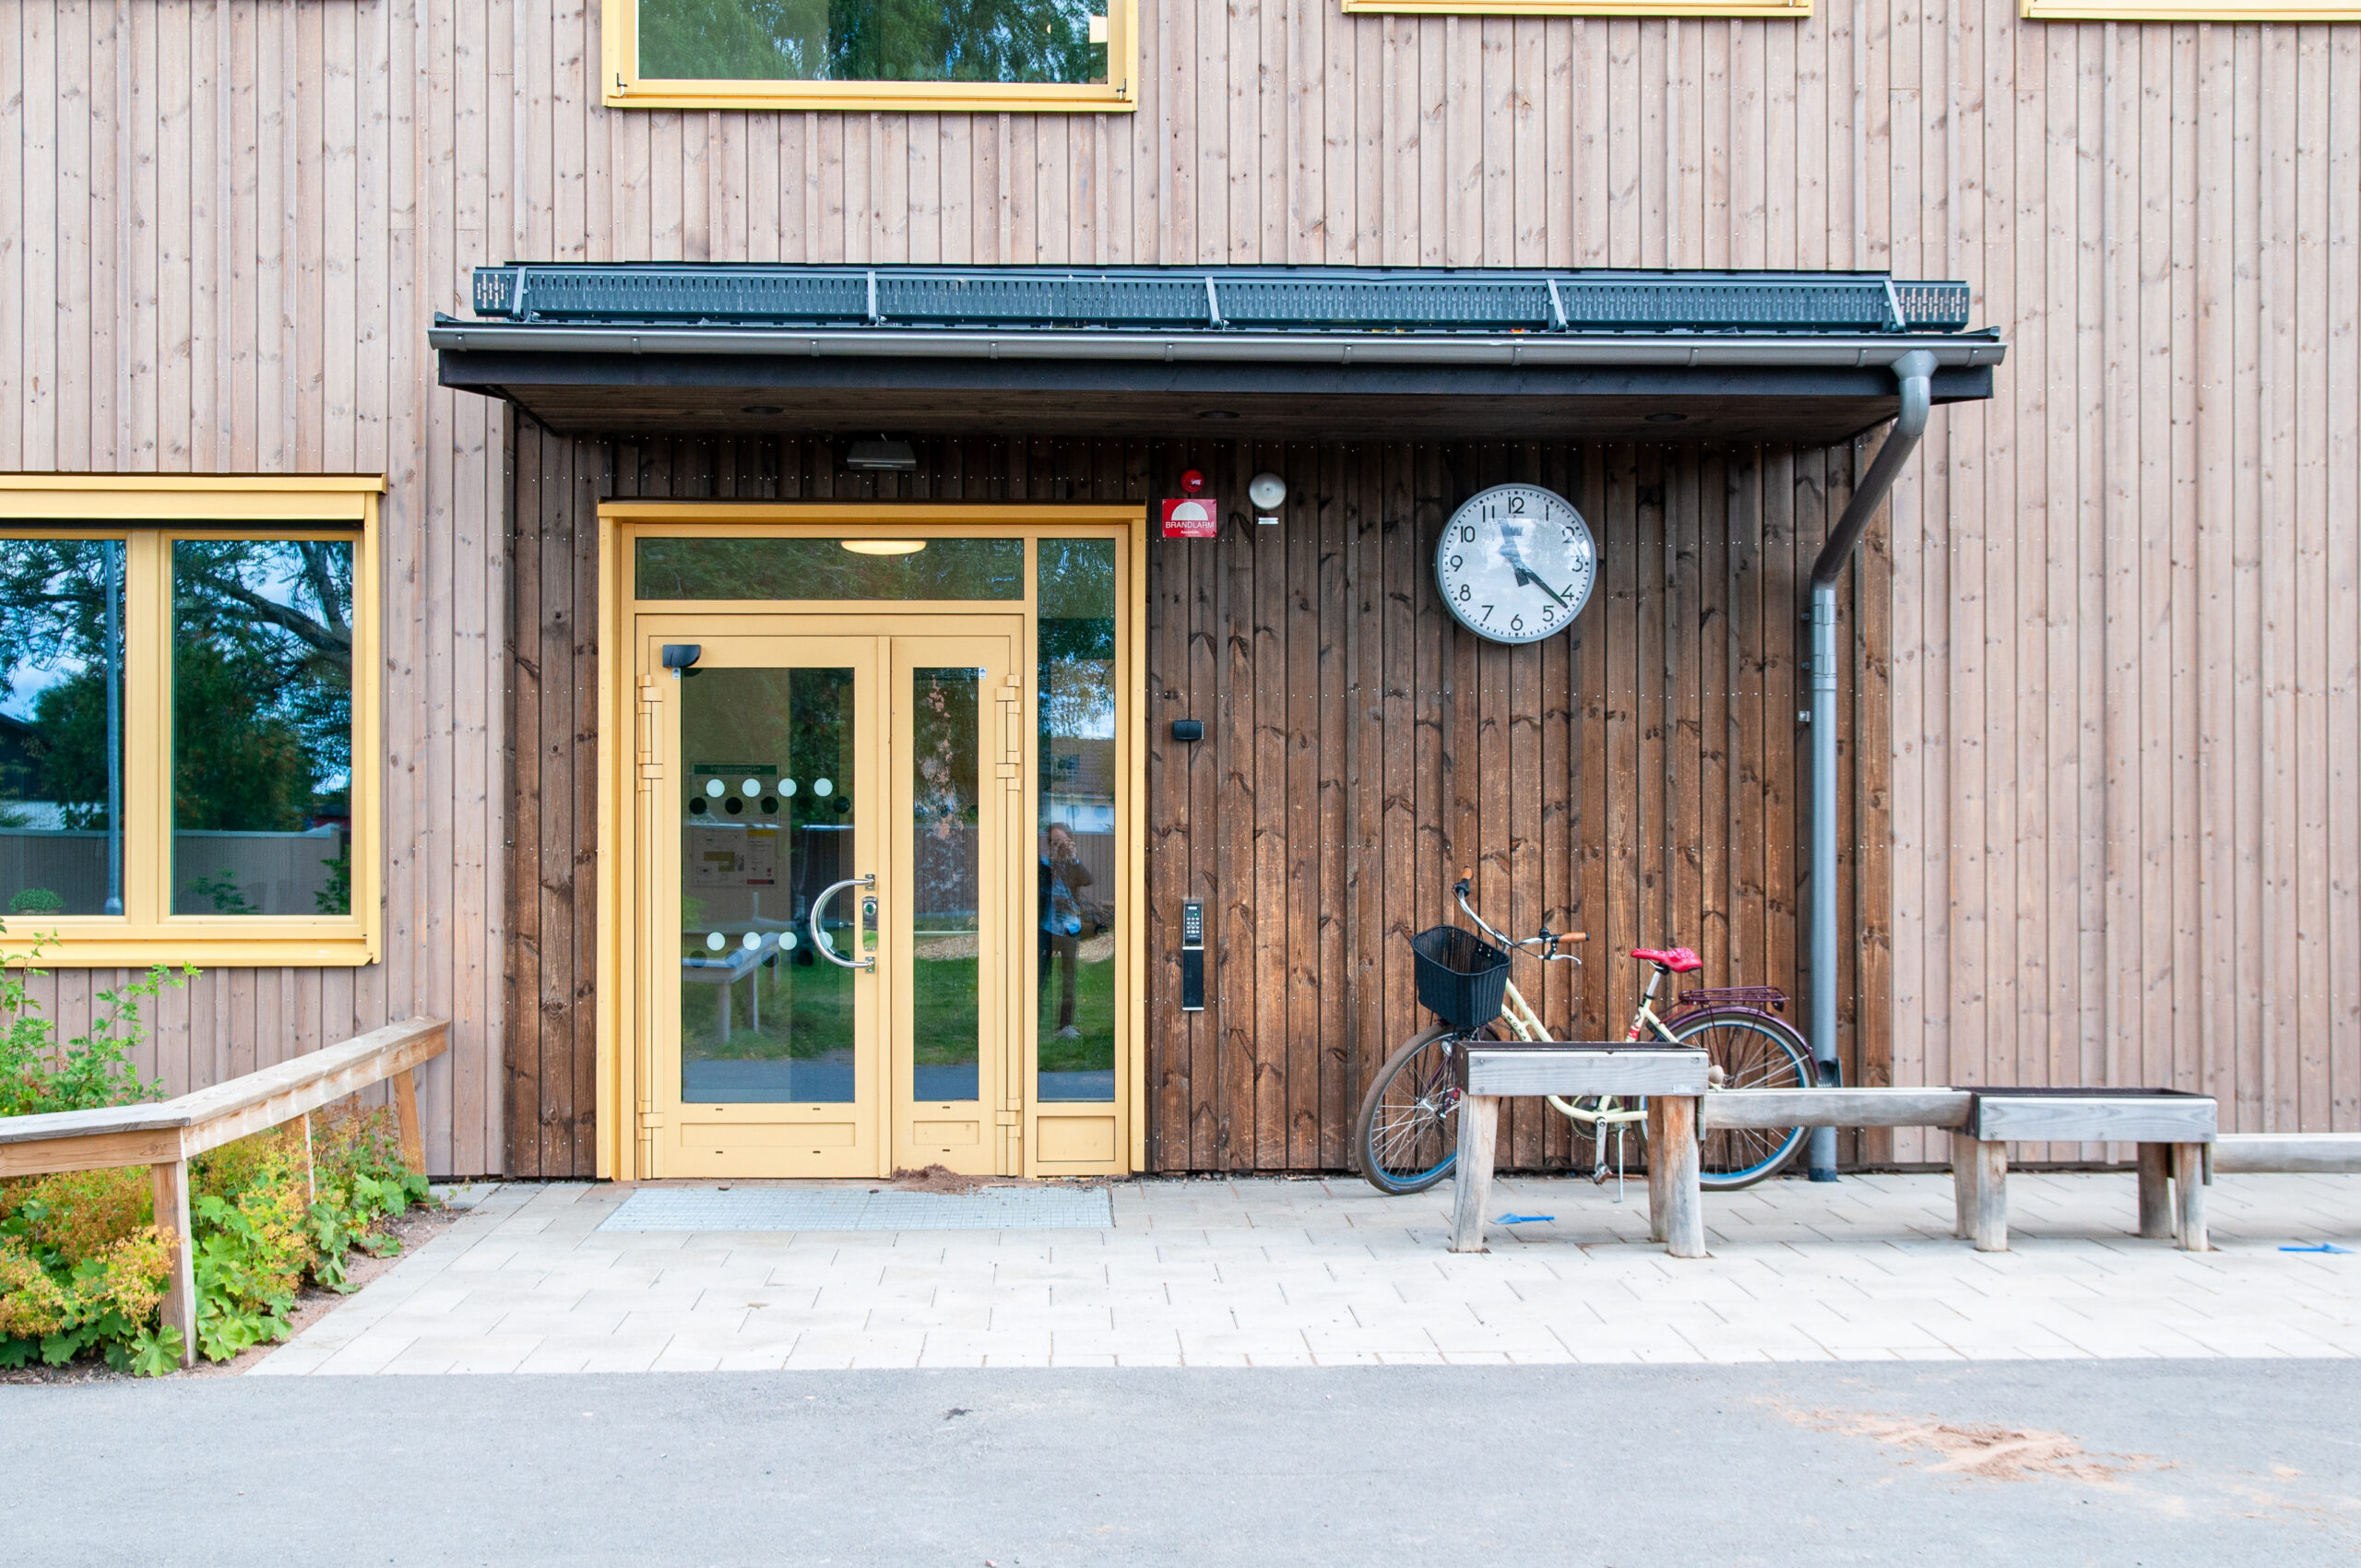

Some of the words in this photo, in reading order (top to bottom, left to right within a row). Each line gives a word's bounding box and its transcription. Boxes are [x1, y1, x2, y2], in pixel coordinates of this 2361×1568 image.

[1508, 496, 1525, 514] 12
[1545, 505, 1549, 521] 1
[1482, 505, 1495, 523] 11
[1460, 526, 1476, 542] 10
[1561, 526, 1575, 543] 2
[1450, 554, 1463, 572] 9
[1572, 555, 1584, 572] 3
[1459, 584, 1471, 601] 8
[1560, 584, 1574, 601] 4
[1481, 605, 1495, 622] 7
[1510, 613, 1524, 631] 6
[1542, 605, 1555, 622] 5
